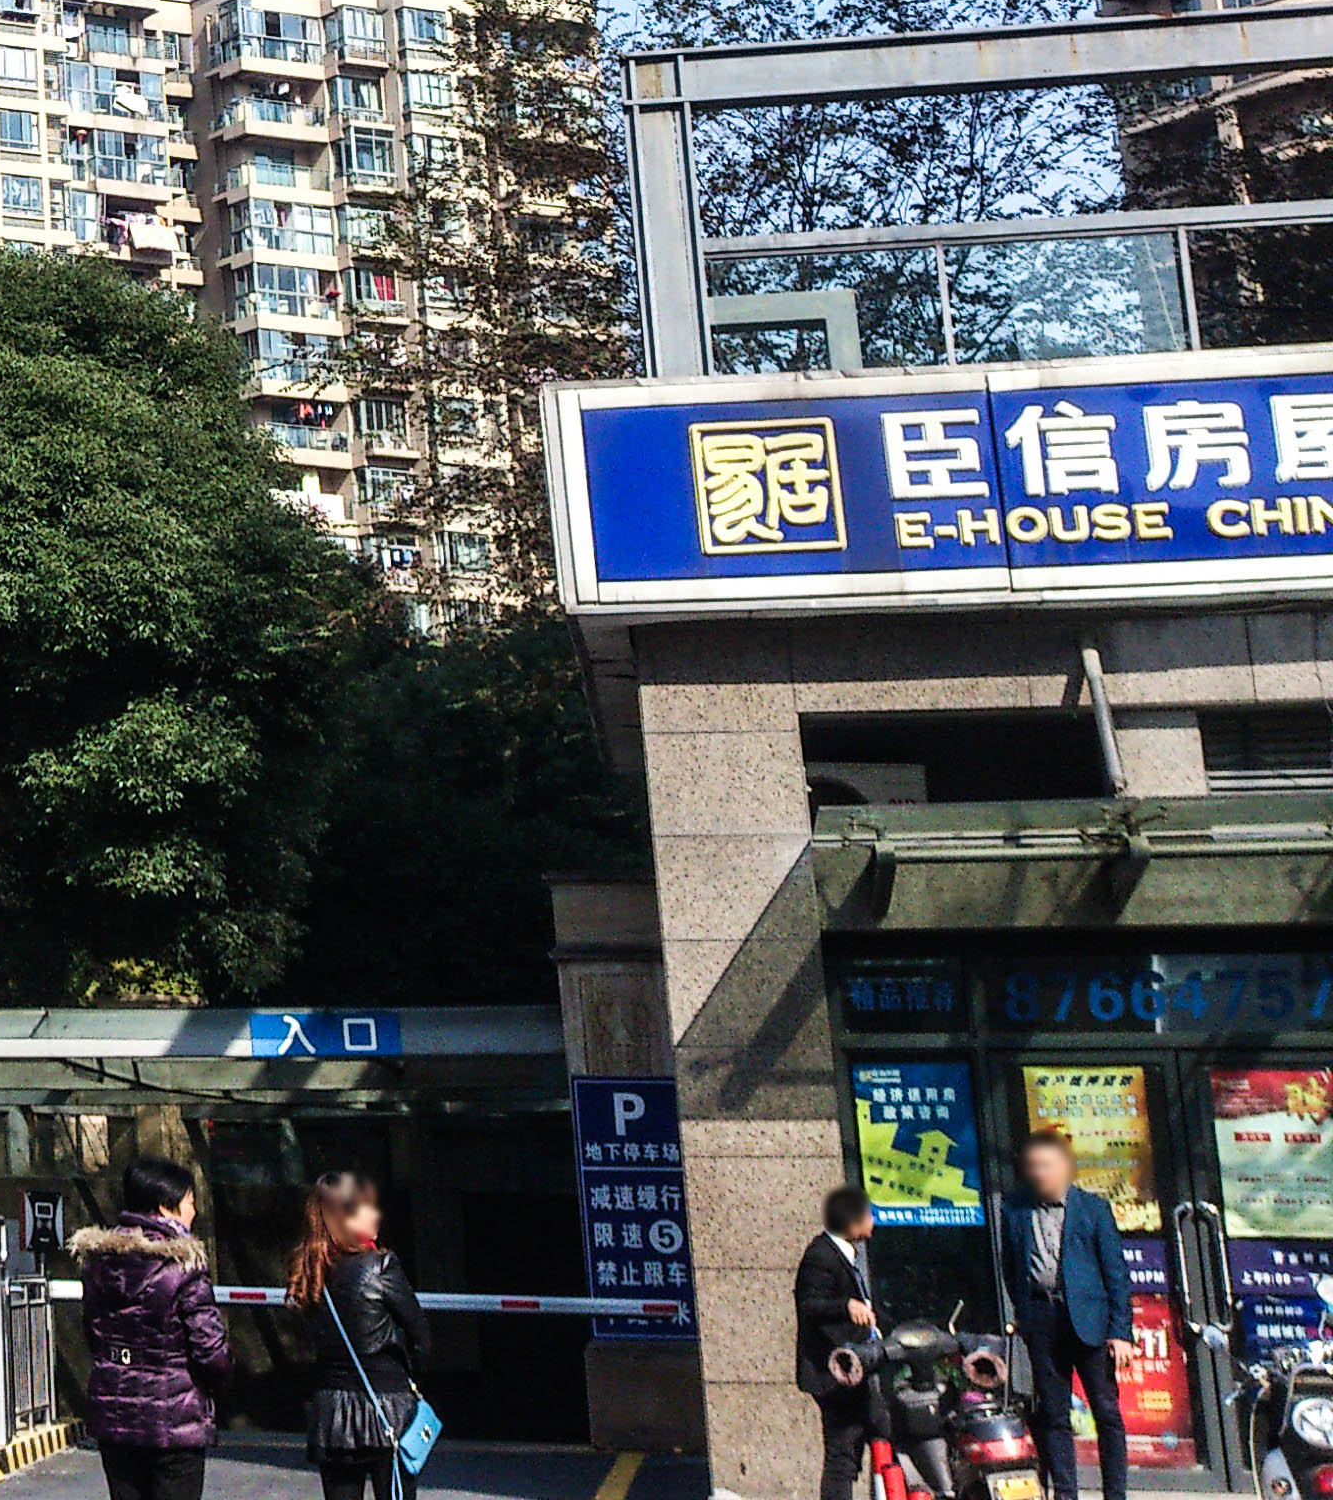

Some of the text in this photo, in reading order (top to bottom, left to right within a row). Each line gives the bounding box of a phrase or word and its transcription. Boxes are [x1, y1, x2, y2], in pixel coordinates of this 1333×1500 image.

[880, 393, 1333, 500] 臣信房屋
[894, 501, 1173, 549] E-HOUSE
[278, 1015, 377, 1055] 入口
[613, 1092, 645, 1136] P
[585, 1142, 680, 1162] 地下停车场
[590, 1184, 681, 1211] 减速缓行
[597, 1261, 688, 1288] 禁止跟车
